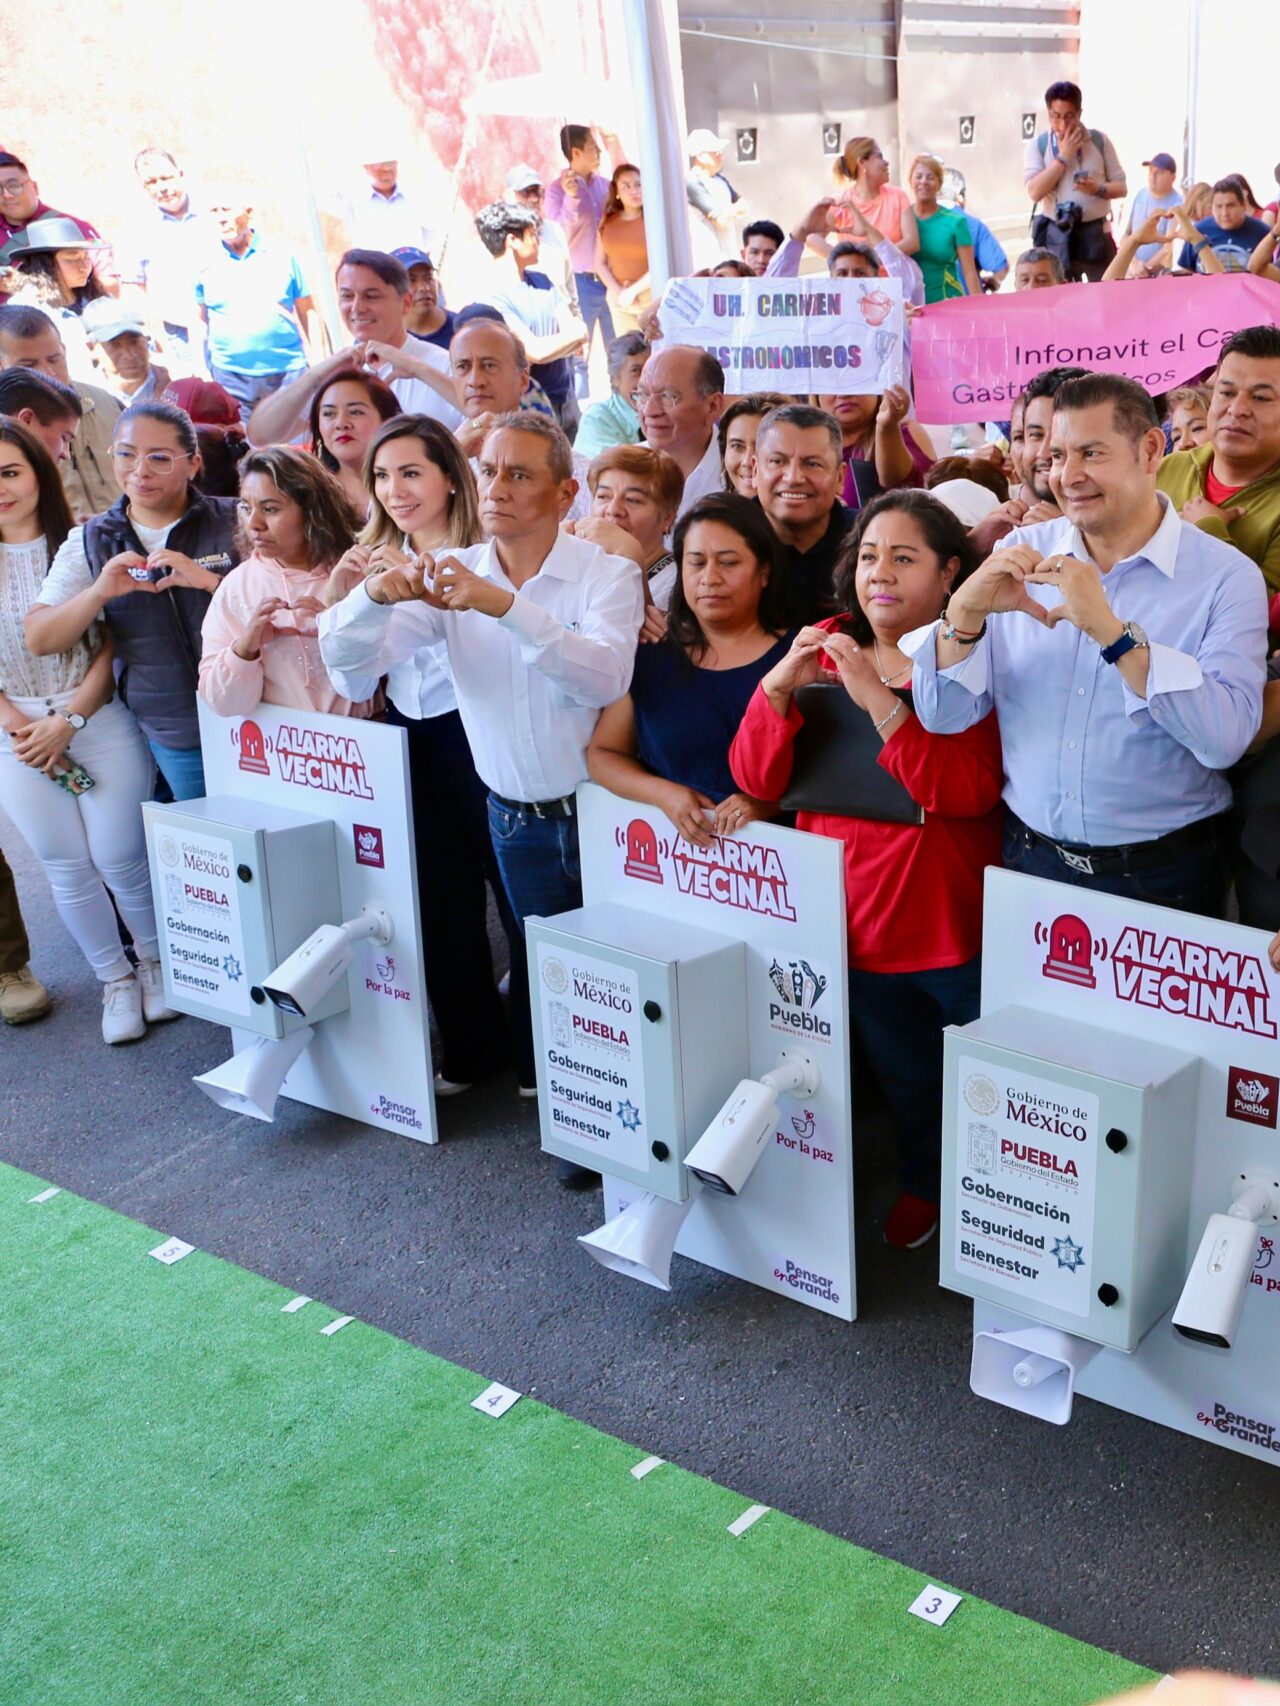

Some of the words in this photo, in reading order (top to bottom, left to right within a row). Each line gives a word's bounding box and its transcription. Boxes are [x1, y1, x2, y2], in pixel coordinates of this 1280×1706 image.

[757, 292, 841, 317] CARMEN
[1014, 338, 1149, 365] Infonavit
[1160, 331, 1184, 354] el
[275, 725, 366, 770] ALARMA
[277, 750, 375, 800] VECINAL
[181, 842, 217, 859] Gobierno
[219, 852, 228, 862] de
[183, 852, 230, 879] México
[184, 883, 230, 907] PUEBLA
[673, 856, 797, 923] VECINAL
[166, 916, 231, 945] Gobernación
[169, 943, 220, 967] Seguridad
[1110, 926, 1271, 999] ALARMA
[172, 968, 220, 992] Bienestar
[365, 978, 383, 993] Por
[384, 983, 393, 995] la
[394, 989, 411, 1001] paz
[572, 967, 618, 990] Gobierno
[619, 982, 632, 994] de
[573, 978, 632, 1014] México
[1112, 960, 1278, 1040] VECINAL
[572, 1014, 630, 1046] PUEBLA
[769, 1002, 832, 1037] Puebla
[548, 1049, 628, 1089] Gobernación
[379, 1095, 417, 1116] Pensar
[550, 1079, 613, 1113] Seguridad
[1006, 1086, 1069, 1115] Gobierno
[1072, 1106, 1088, 1121] de
[1234, 1098, 1270, 1116] Puebla
[381, 1109, 423, 1130] Grande
[553, 1108, 611, 1140] Bienestar
[1006, 1099, 1087, 1142] México
[775, 1132, 797, 1149] Por
[799, 1139, 810, 1154] la
[812, 1145, 834, 1163] paz
[1001, 1139, 1079, 1178] PUEBLA
[1000, 1155, 1037, 1174] Gobierno
[1037, 1167, 1050, 1178] del
[1050, 1171, 1079, 1188] Estado
[961, 1176, 1071, 1224] Gobernación
[961, 1209, 1045, 1250] Seguridad
[163, 1247, 181, 1257] 5
[960, 1240, 1040, 1280] Bienestar
[785, 1259, 834, 1288] Pensar
[787, 1275, 840, 1304] Grande
[487, 1394, 504, 1408] 4
[1196, 1410, 1218, 1427] en
[1213, 1402, 1276, 1436] Pensar
[924, 1597, 943, 1614] 3
